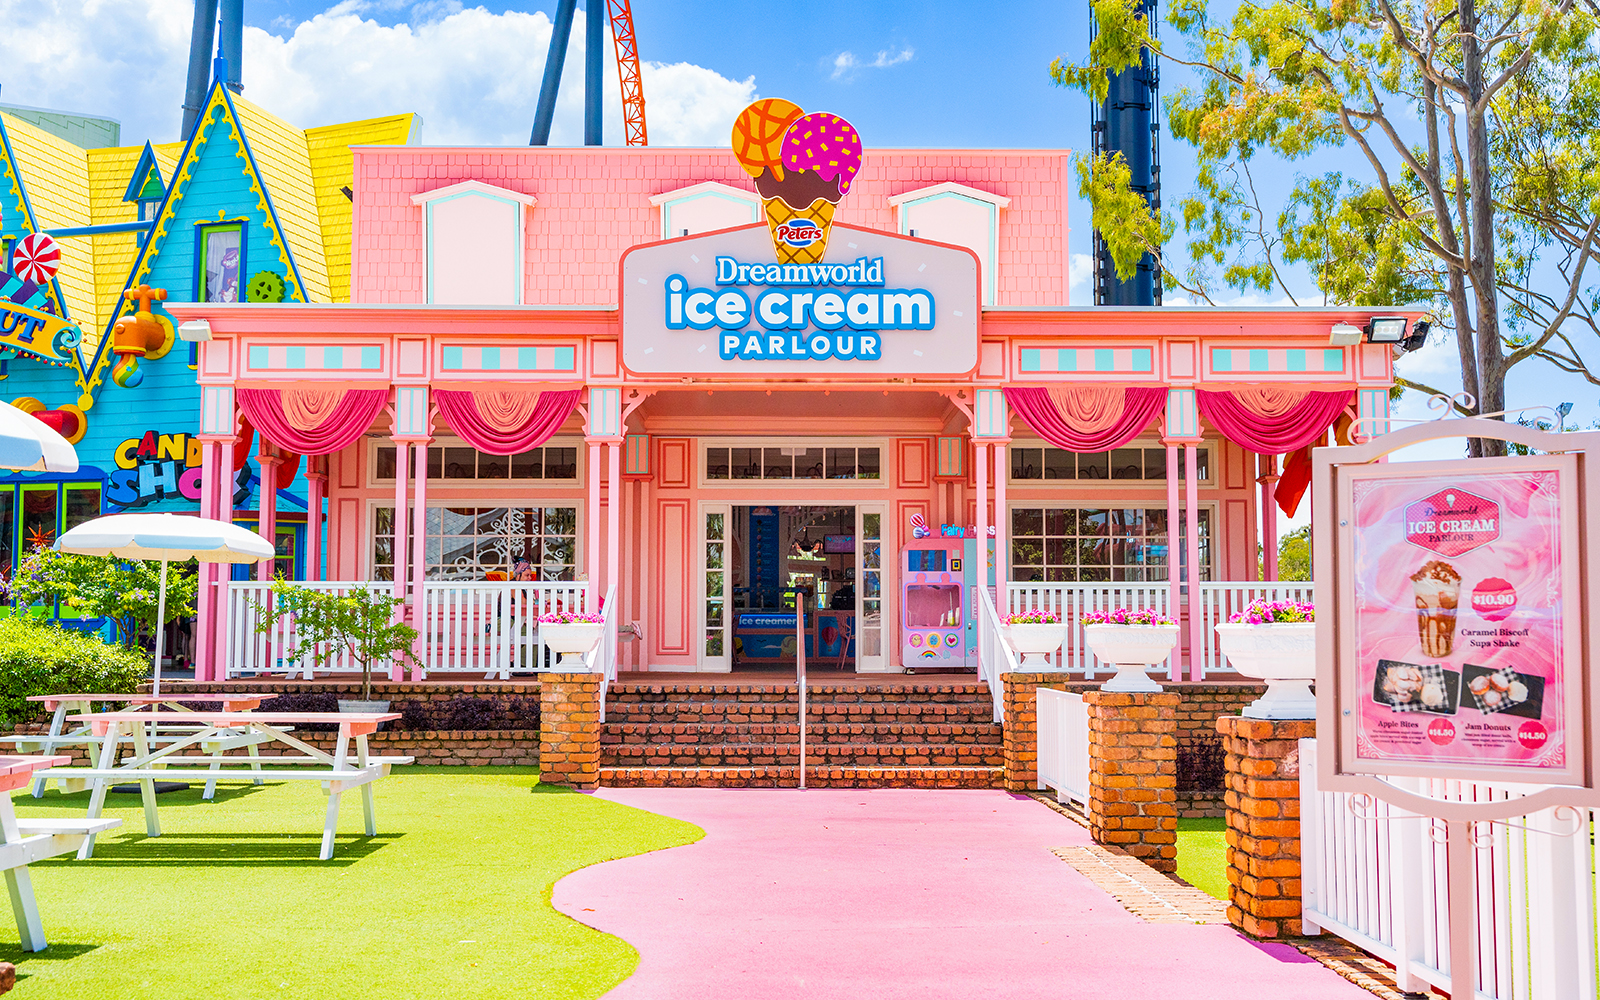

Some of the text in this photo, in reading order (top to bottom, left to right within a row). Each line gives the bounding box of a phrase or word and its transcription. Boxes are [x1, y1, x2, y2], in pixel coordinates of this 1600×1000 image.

[777, 226, 822, 242] Peters
[717, 256, 884, 283] Dreamworld
[669, 278, 931, 325] ice cream
[724, 334, 876, 355] PARLOUR
[114, 430, 203, 470] CAND
[107, 460, 241, 504] SHO
[1424, 505, 1478, 516] Dreamworld
[941, 523, 965, 538] Fairy
[1408, 519, 1495, 534] ICE CREAM
[1429, 533, 1474, 542] PARLOUR
[1473, 594, 1514, 606] $10.90
[739, 616, 753, 625] ice
[1461, 628, 1529, 637] Caramel Biscoff
[1470, 639, 1520, 649] Supa Shake
[1378, 720, 1419, 729] Apple Bites
[1465, 723, 1512, 731] Jam Donuts
[1428, 729, 1454, 737] $14.50
[1519, 732, 1546, 740] $14.50
